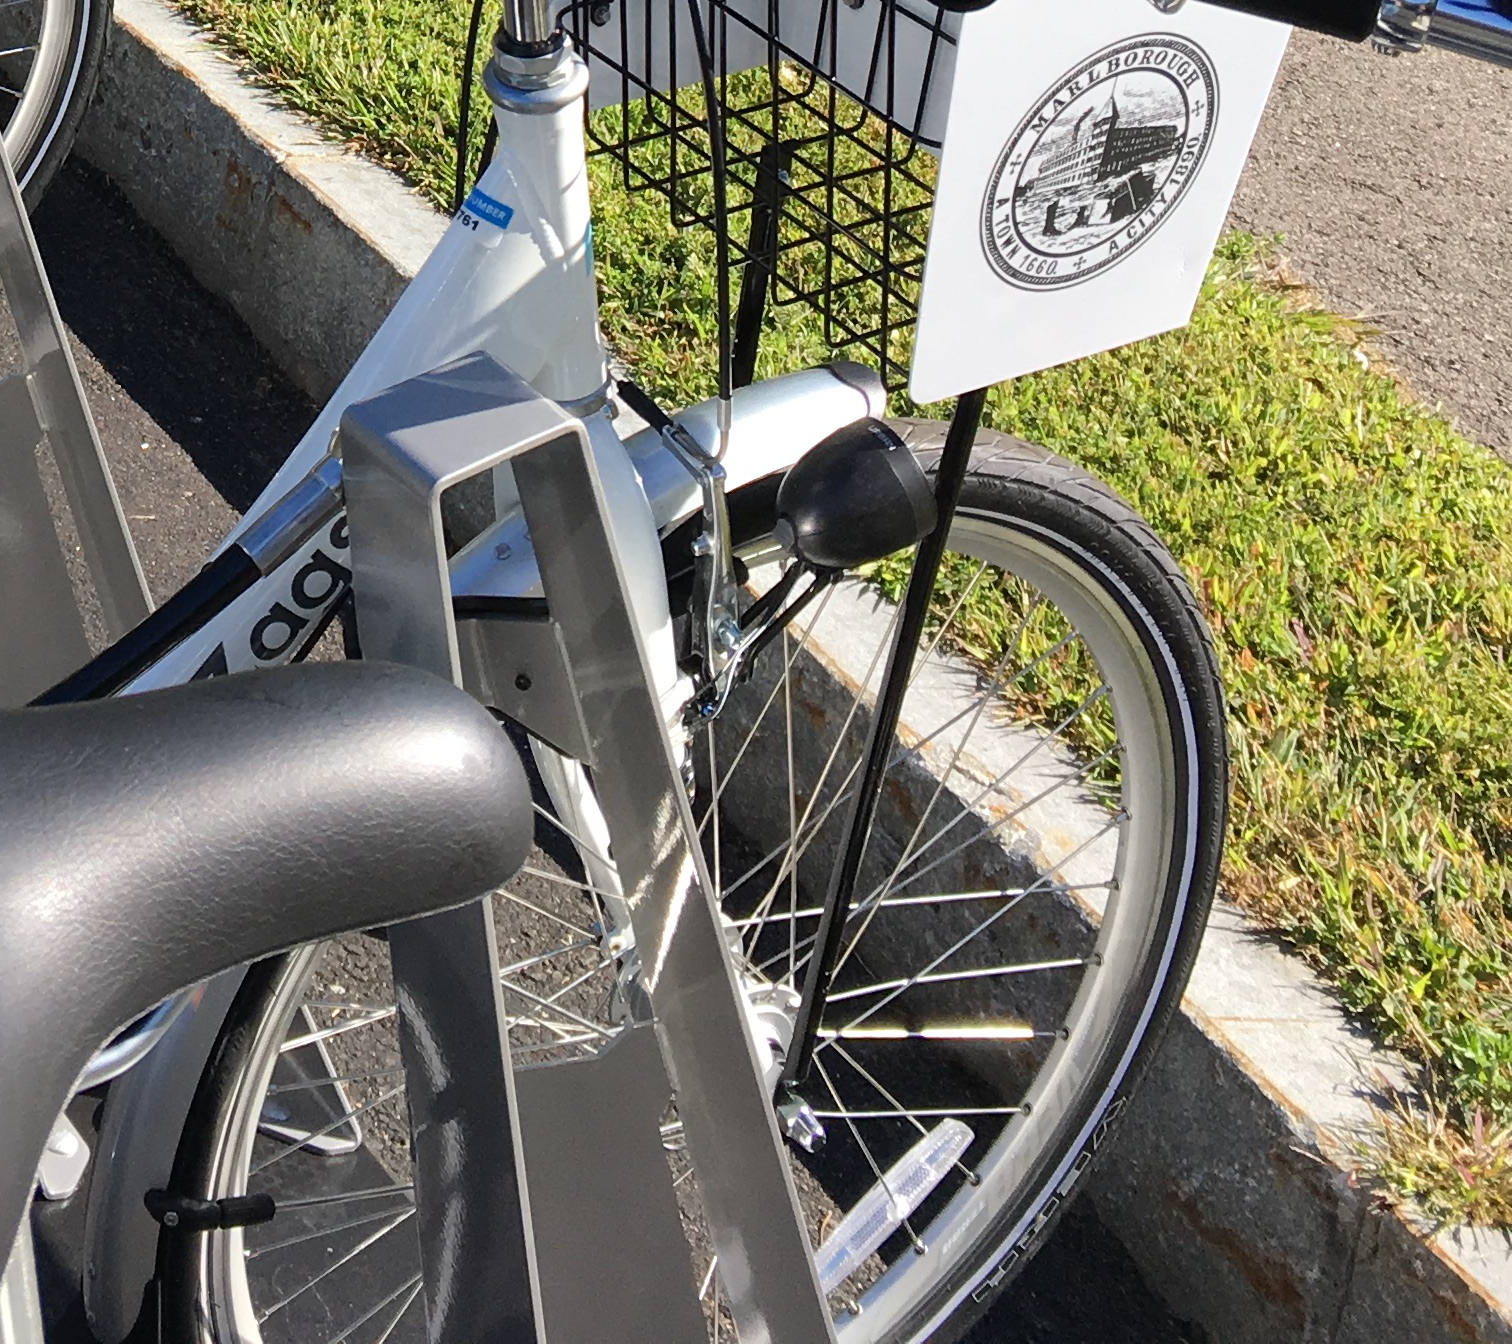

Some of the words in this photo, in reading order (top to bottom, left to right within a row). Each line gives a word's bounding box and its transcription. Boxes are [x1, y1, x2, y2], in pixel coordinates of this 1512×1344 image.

[1029, 48, 1200, 136] MARLBOROUGH
[471, 196, 507, 221] UMBER
[1107, 240, 1120, 256] A
[1127, 192, 1170, 242] CITY
[996, 214, 1021, 261] TOWN
